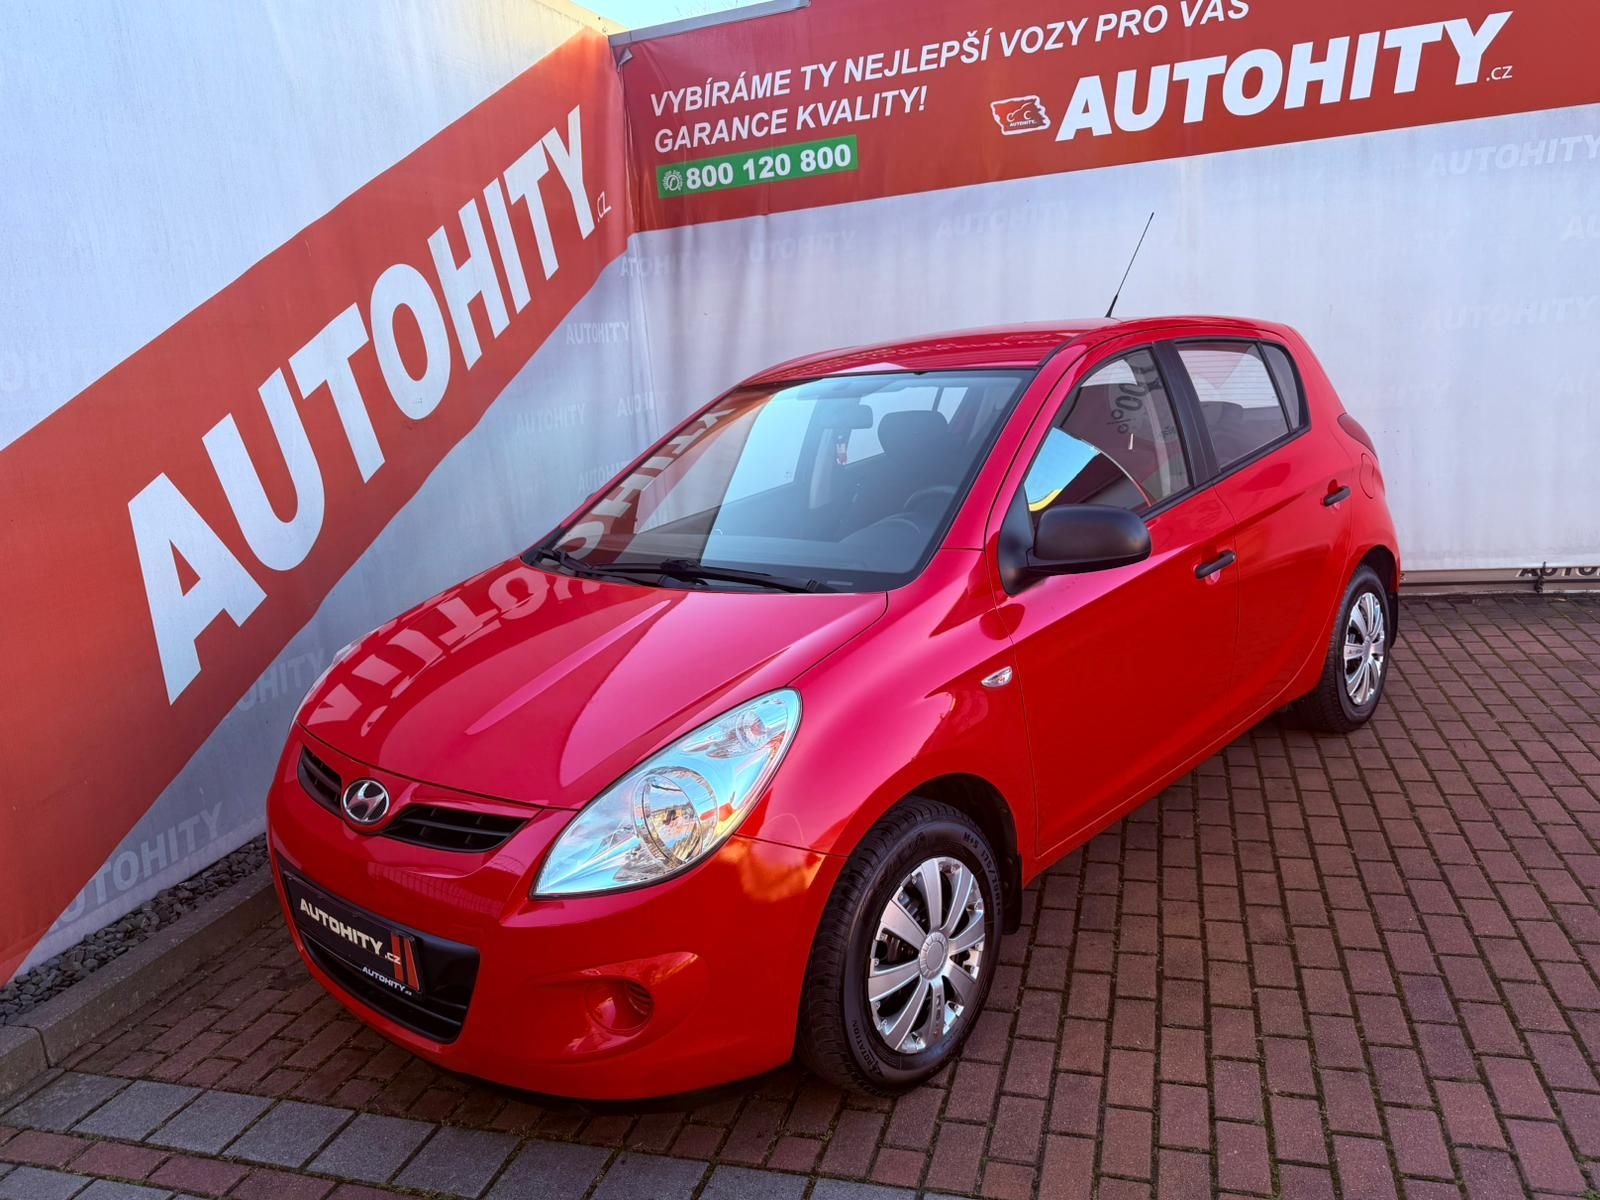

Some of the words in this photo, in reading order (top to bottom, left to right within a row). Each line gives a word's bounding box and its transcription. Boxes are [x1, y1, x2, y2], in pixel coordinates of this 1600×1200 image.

[650, 69, 791, 117] VYBÍRÁME
[801, 61, 837, 91] TY
[844, 27, 992, 84] NEJLEPŠÍ
[1000, 17, 1088, 57] VOZY
[1095, 4, 1169, 42] PRO
[1055, 11, 1513, 142] AUTOHITY
[655, 108, 788, 153] GARANCE
[796, 85, 928, 130] KVALITY!
[686, 163, 733, 190] 800
[743, 153, 791, 180] 120
[800, 143, 851, 172] 800
[128, 105, 595, 706] AUTOHITY
[300, 898, 383, 955] AUTOHITY
[362, 966, 405, 992] AUTOHITY
